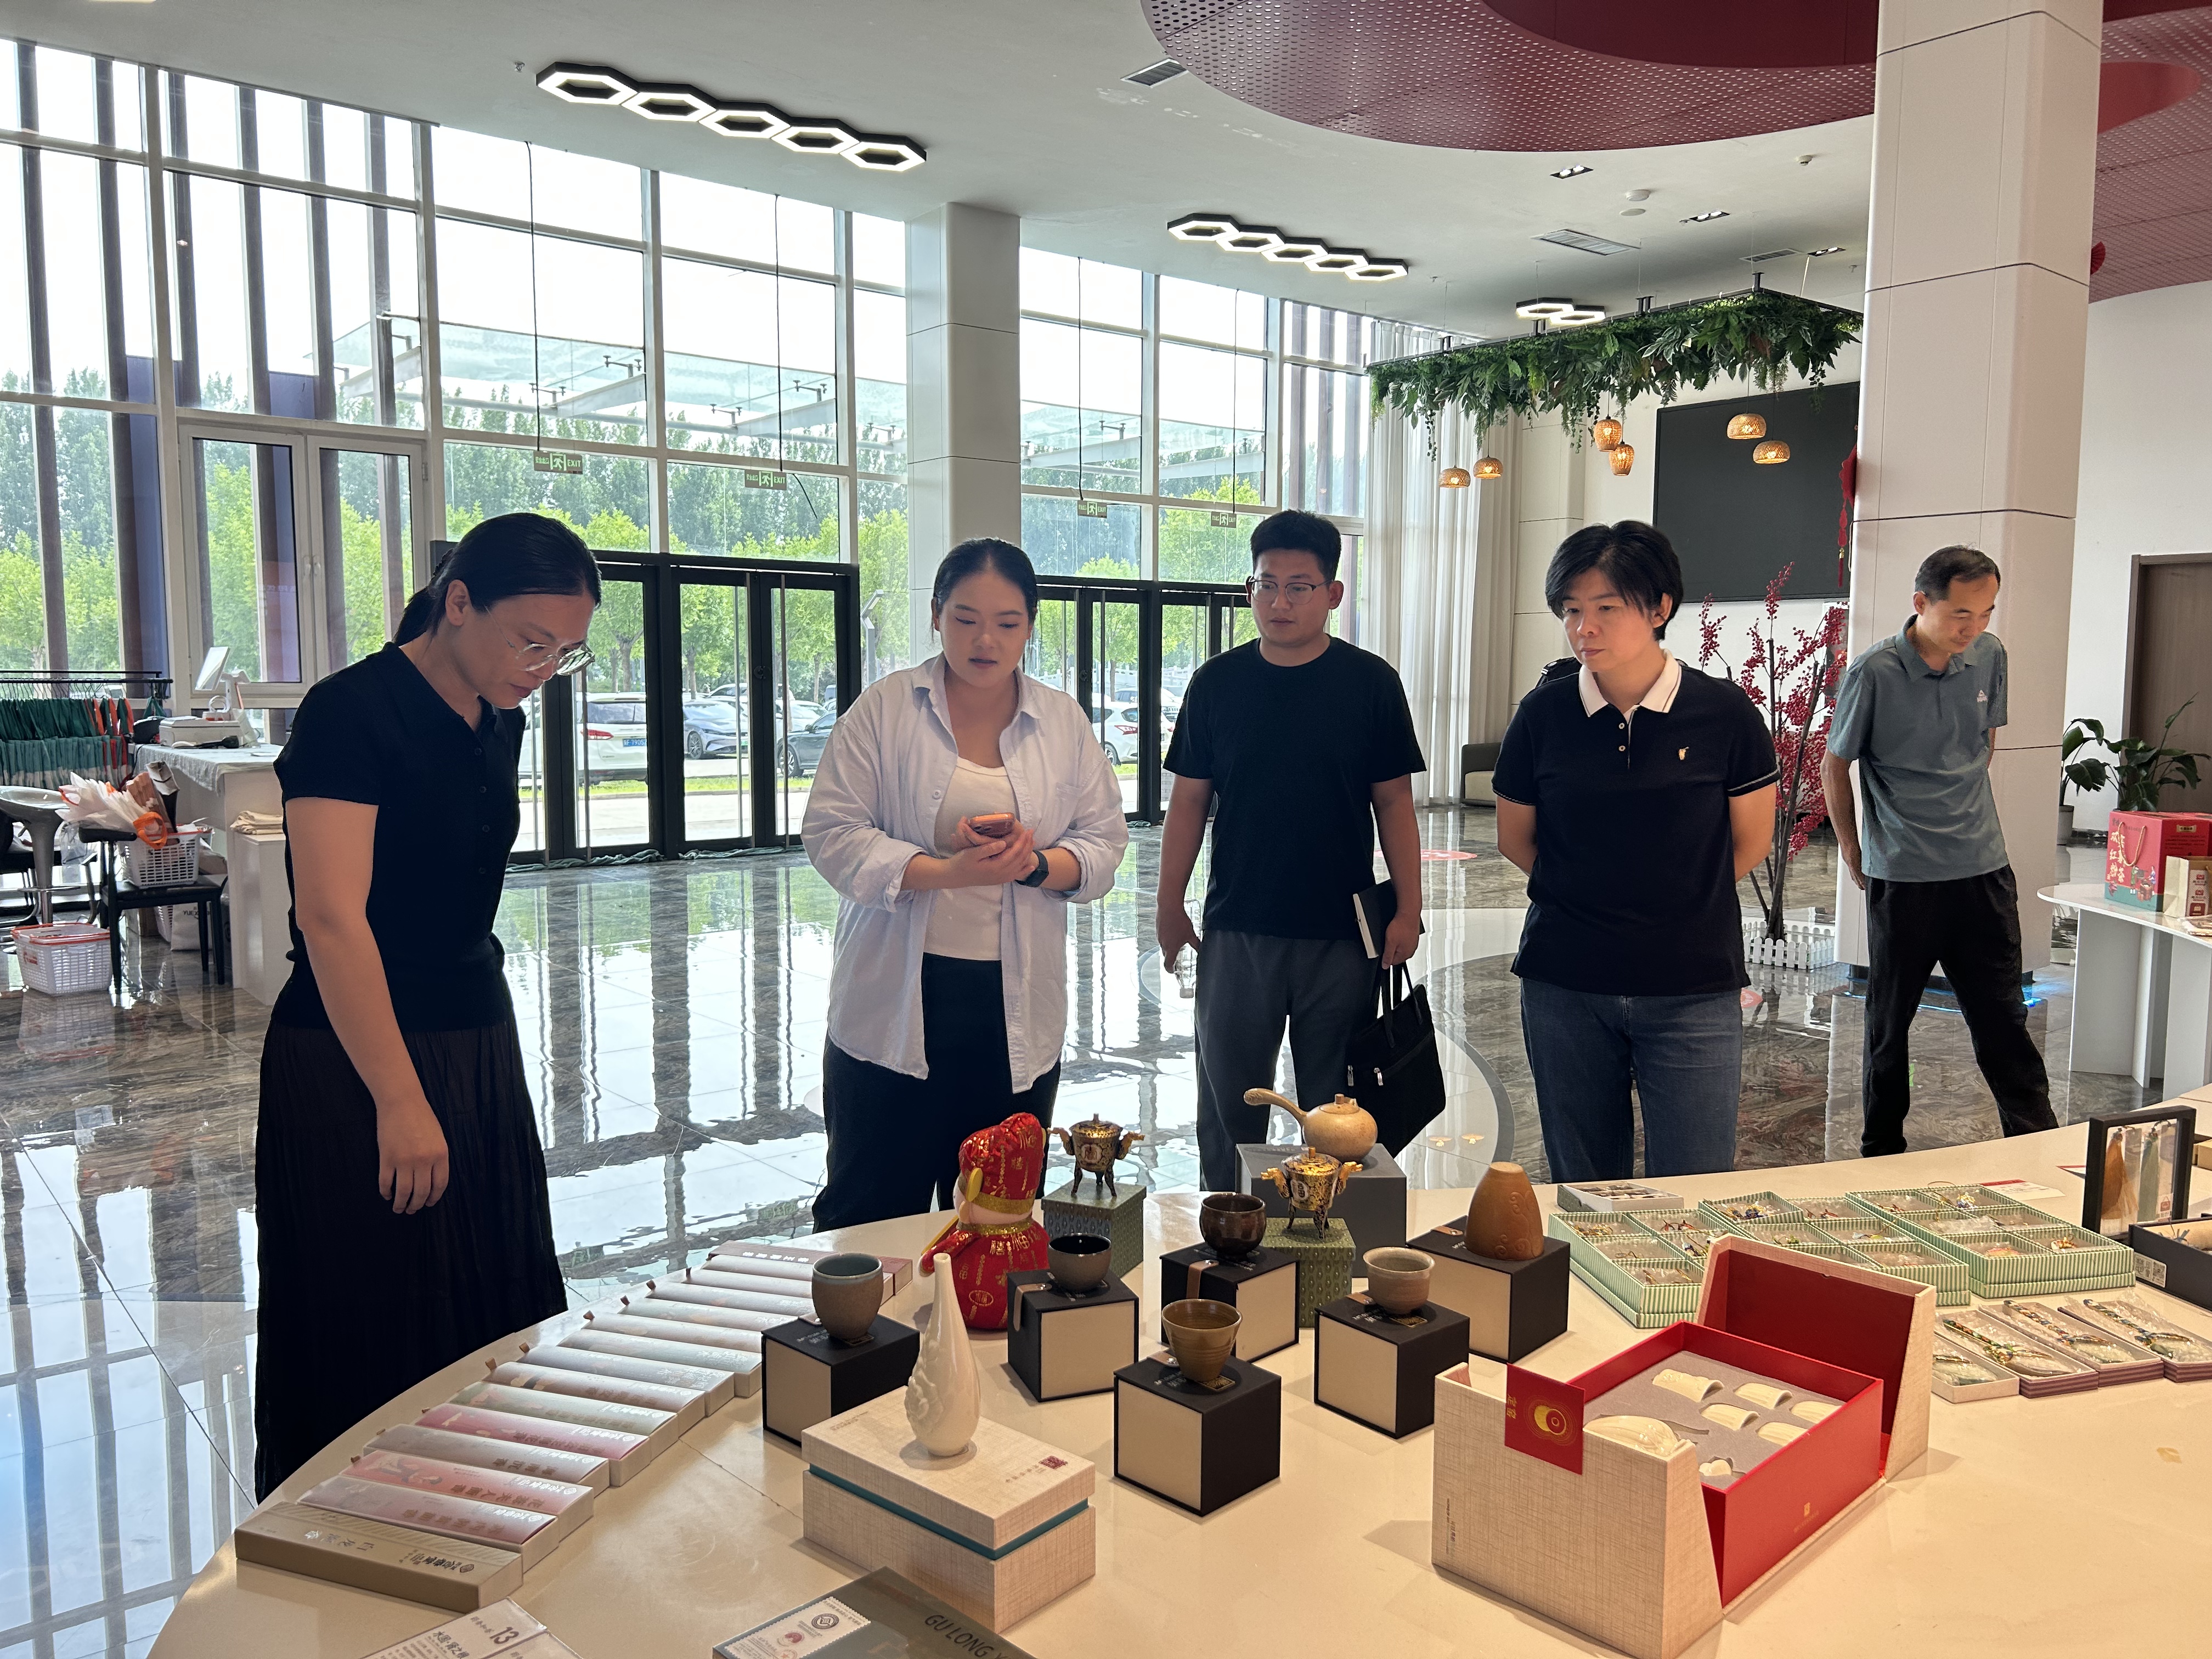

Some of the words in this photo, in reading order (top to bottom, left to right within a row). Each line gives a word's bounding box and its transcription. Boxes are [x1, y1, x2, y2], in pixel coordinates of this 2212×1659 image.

[489, 1627, 519, 1644] 13
[924, 1615, 954, 1631] GU
[945, 1627, 994, 1657] LONG
